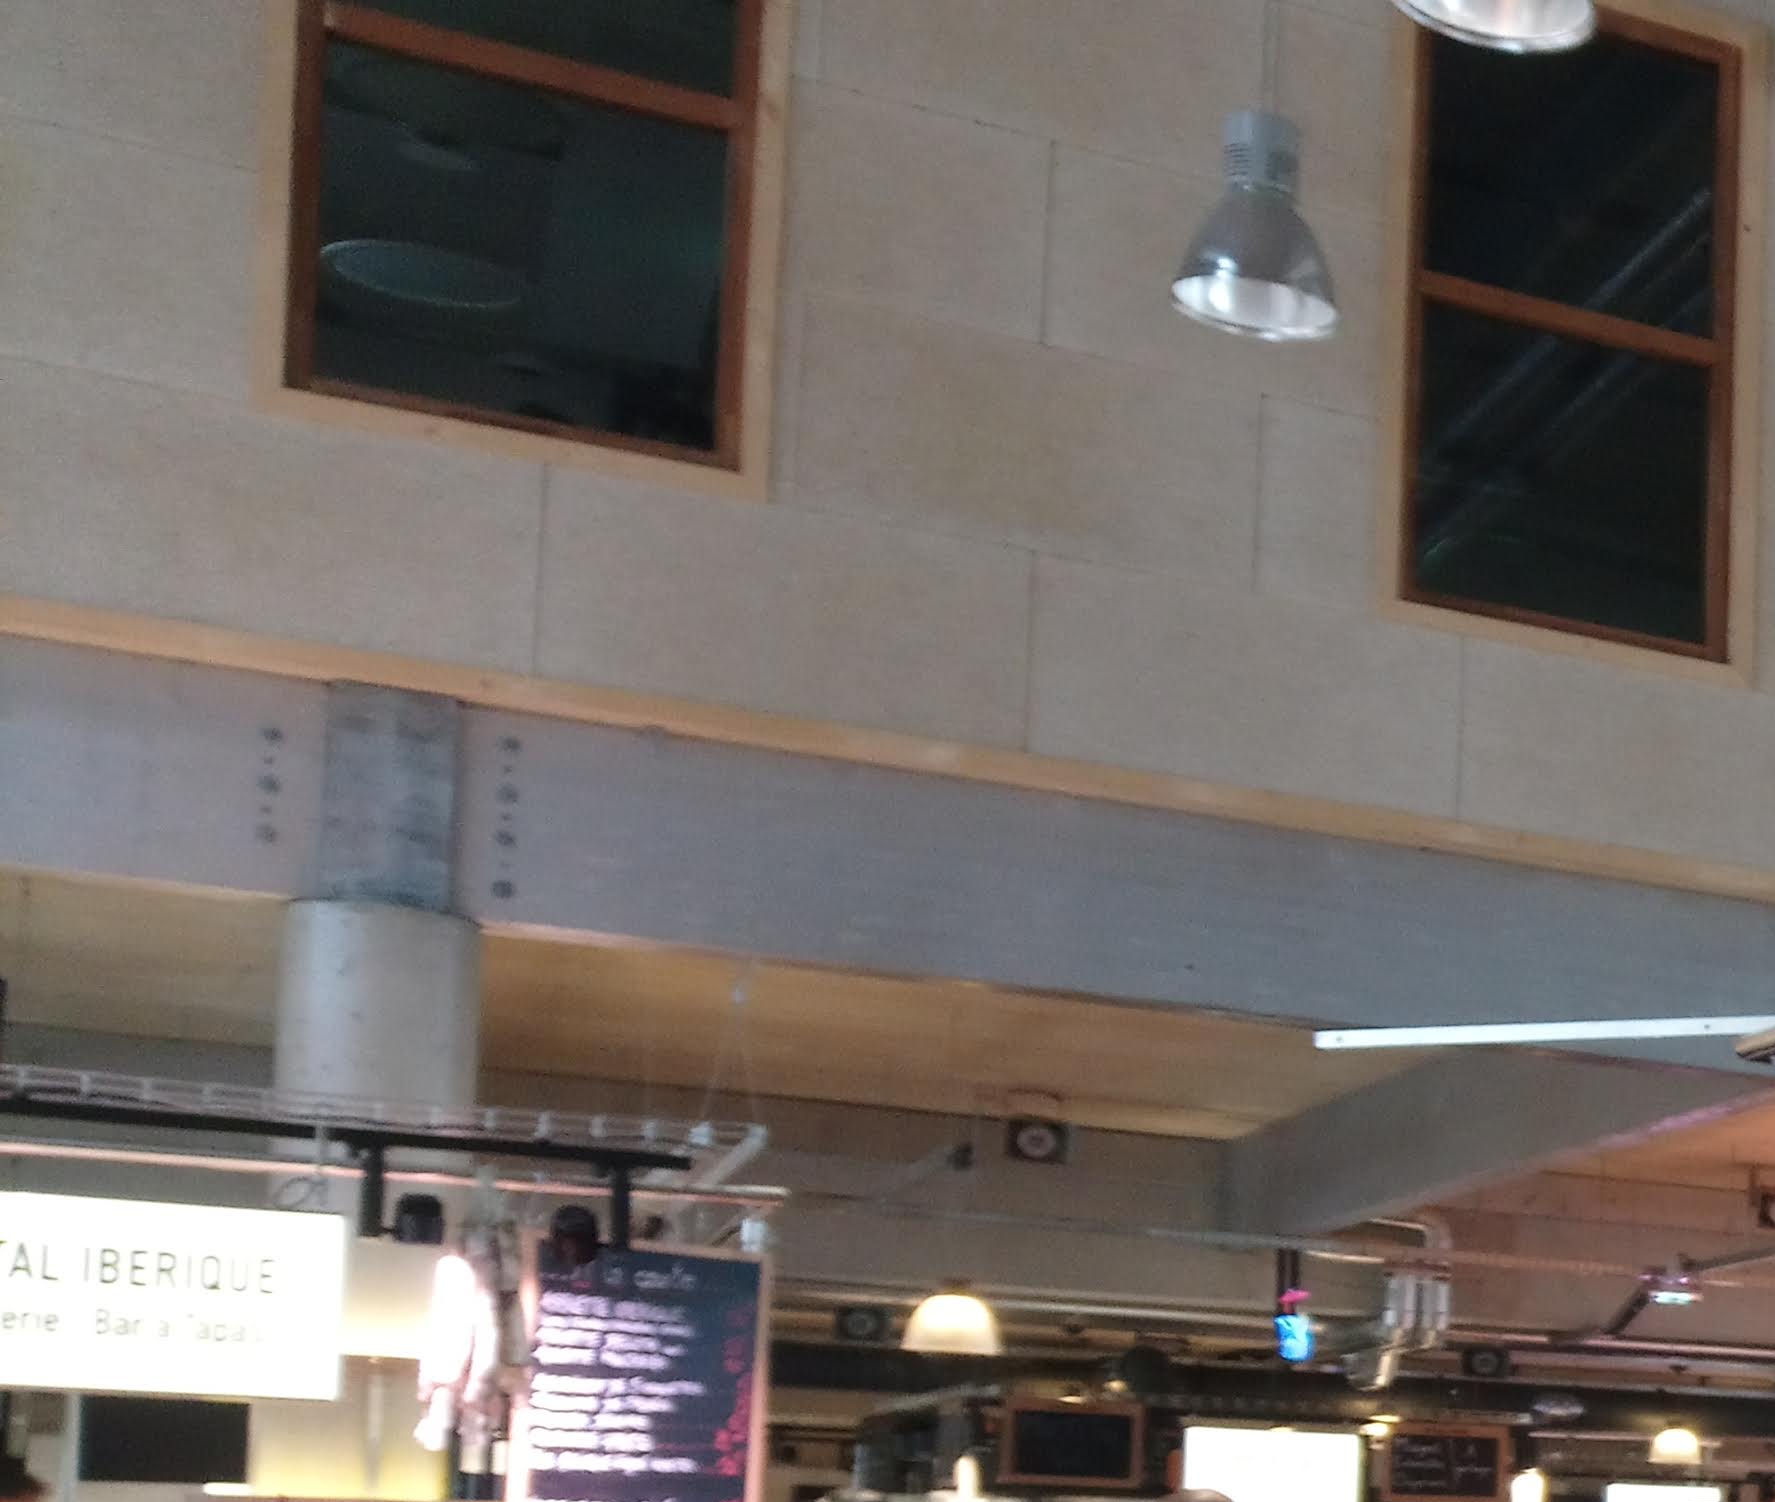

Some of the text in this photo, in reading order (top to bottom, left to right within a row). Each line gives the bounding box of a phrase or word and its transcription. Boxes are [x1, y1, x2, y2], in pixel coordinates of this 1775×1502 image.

[0, 1240, 275, 1294] AL IBERIQUE
[95, 1307, 142, 1336] Bar
